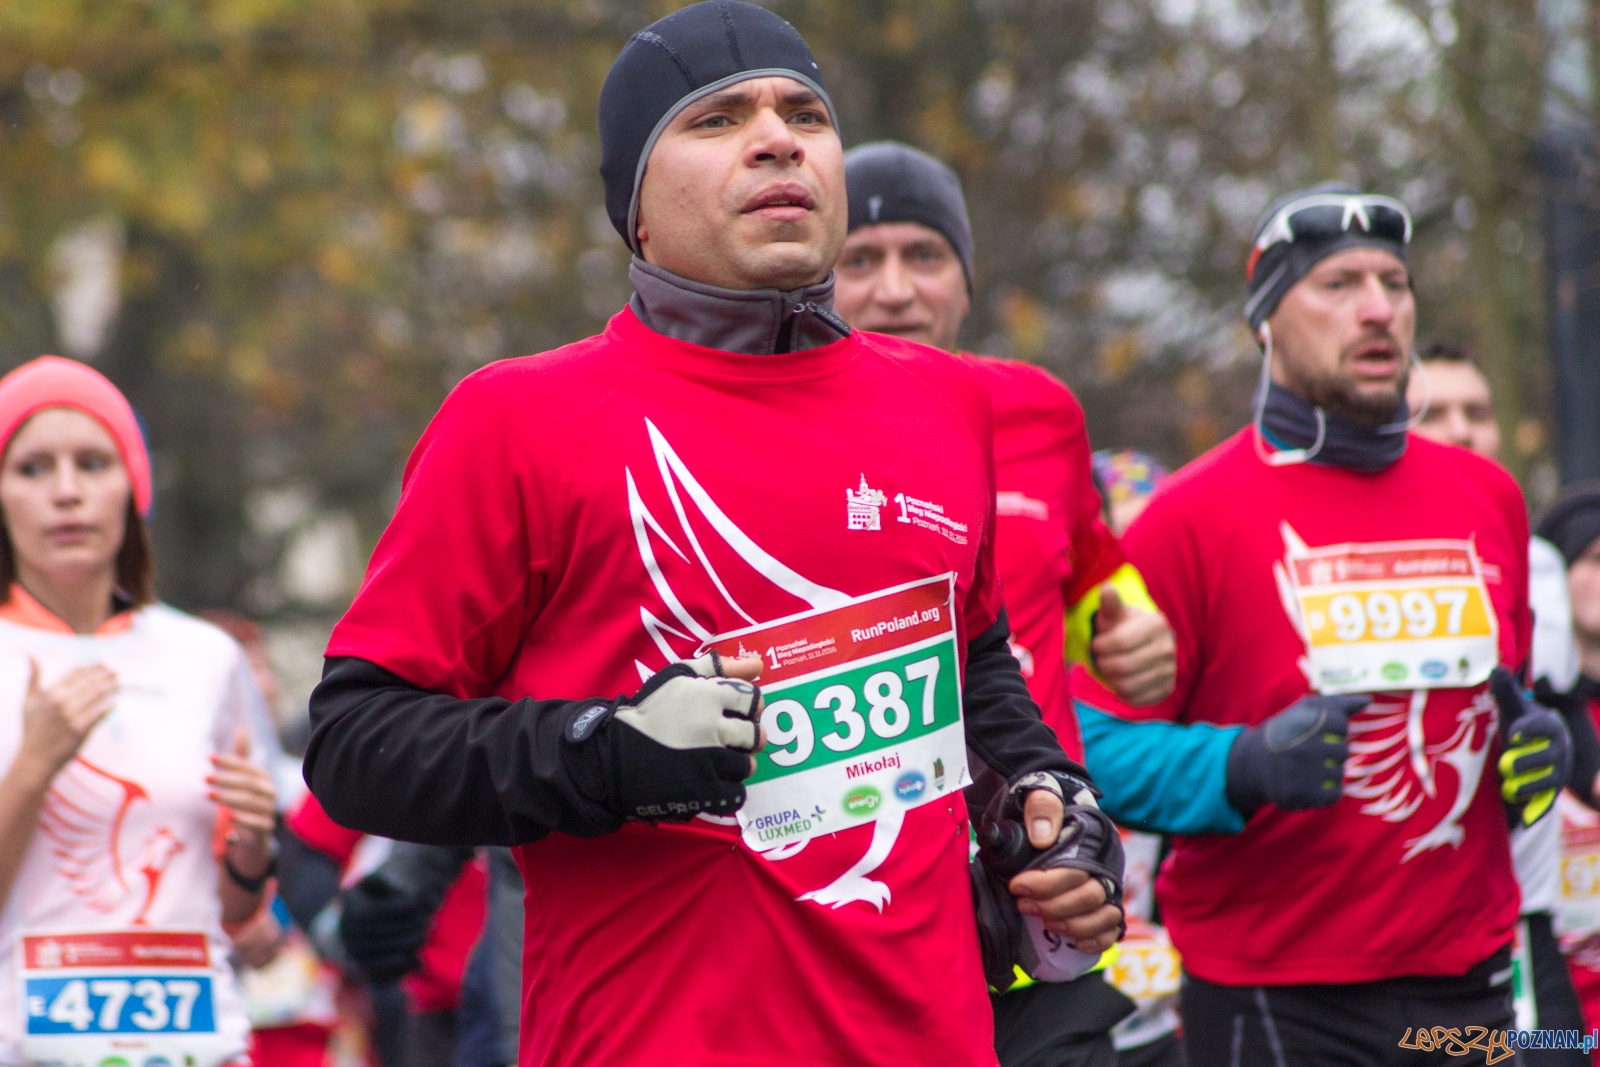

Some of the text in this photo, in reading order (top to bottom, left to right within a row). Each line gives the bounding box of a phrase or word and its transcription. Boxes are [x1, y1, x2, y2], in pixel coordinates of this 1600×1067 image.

[894, 492, 944, 524] 1 Poznański
[907, 504, 924, 517] Bieg
[850, 606, 940, 643] RunPoland.org
[1329, 591, 1468, 641] 9997
[766, 638, 808, 670] 1 Poznański
[777, 648, 792, 660] Bieg
[760, 655, 941, 768] 9387
[846, 752, 902, 780] Mikołaj
[755, 805, 801, 830] GRUPA
[848, 795, 879, 810] energy
[758, 818, 812, 843] LUXMED
[49, 979, 202, 1031] 4737
